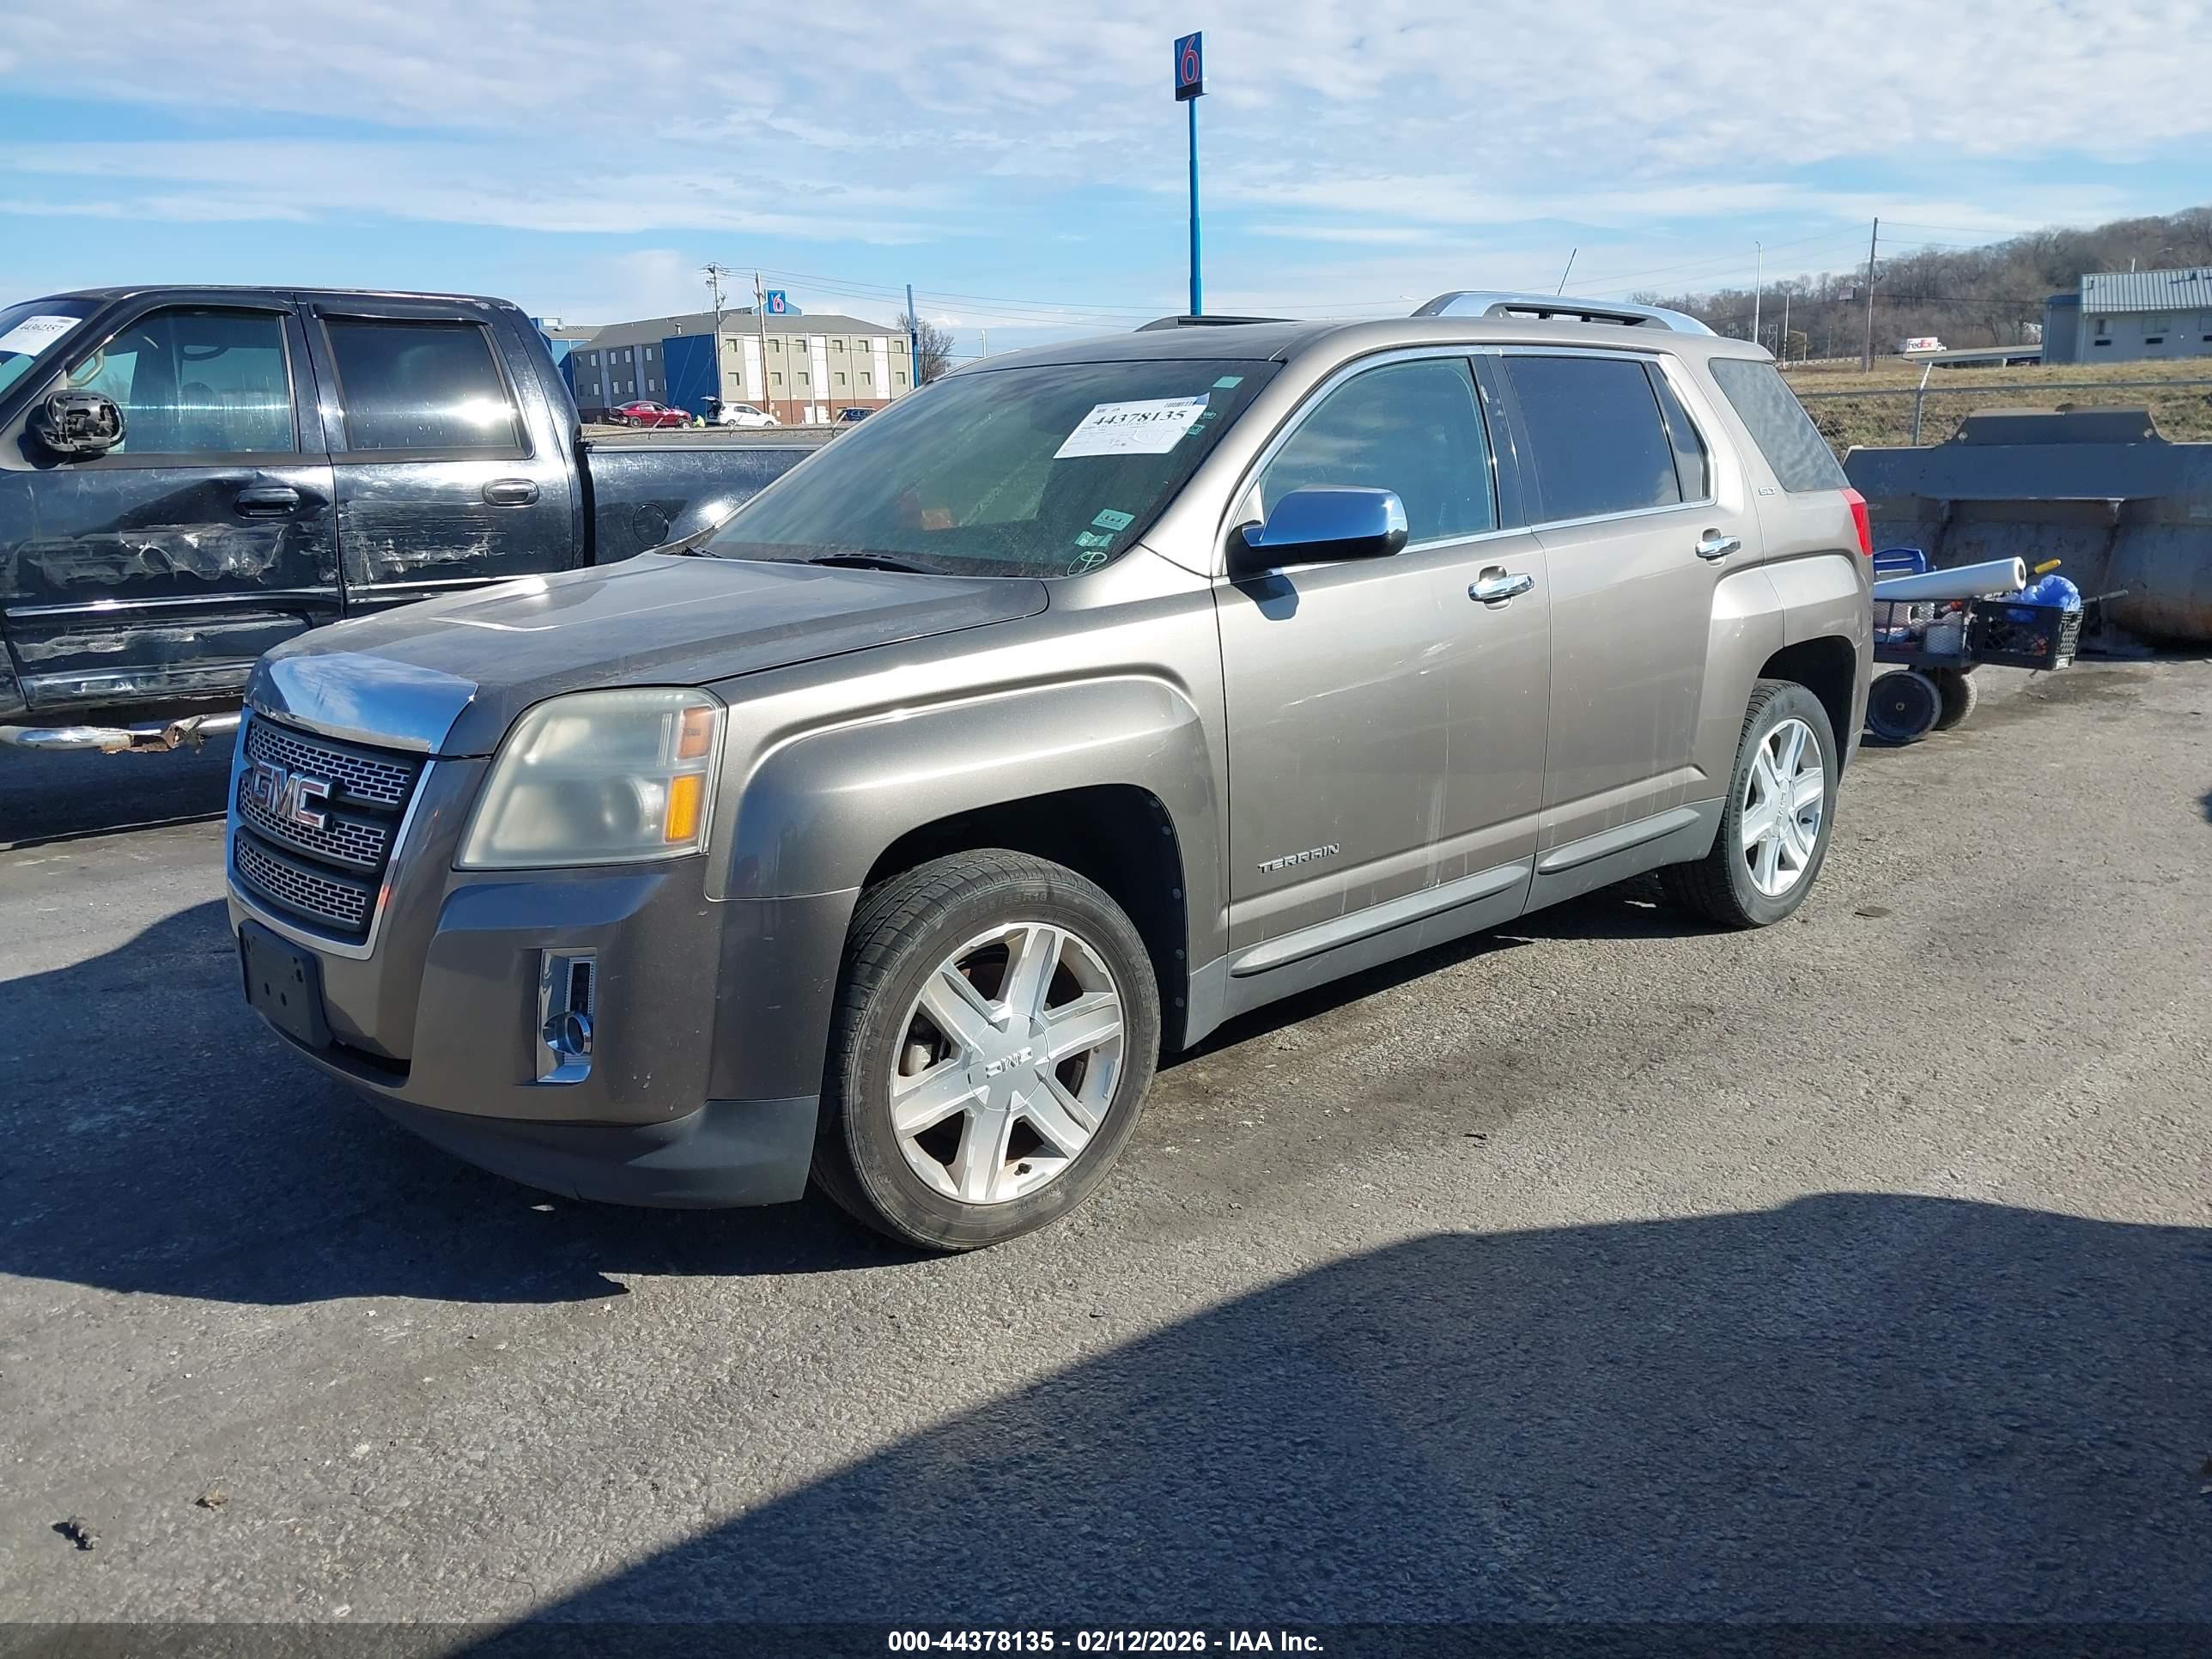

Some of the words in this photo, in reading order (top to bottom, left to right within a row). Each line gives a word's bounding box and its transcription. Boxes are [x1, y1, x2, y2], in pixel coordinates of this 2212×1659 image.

[1181, 34, 1200, 85] 6
[773, 293, 785, 313] 6
[1092, 409, 1188, 427] 44378135
[1758, 487, 1777, 495] SLT
[252, 760, 332, 830] GMC
[1732, 767, 1749, 840] KUMHO
[1257, 842, 1340, 873] TERRAIN
